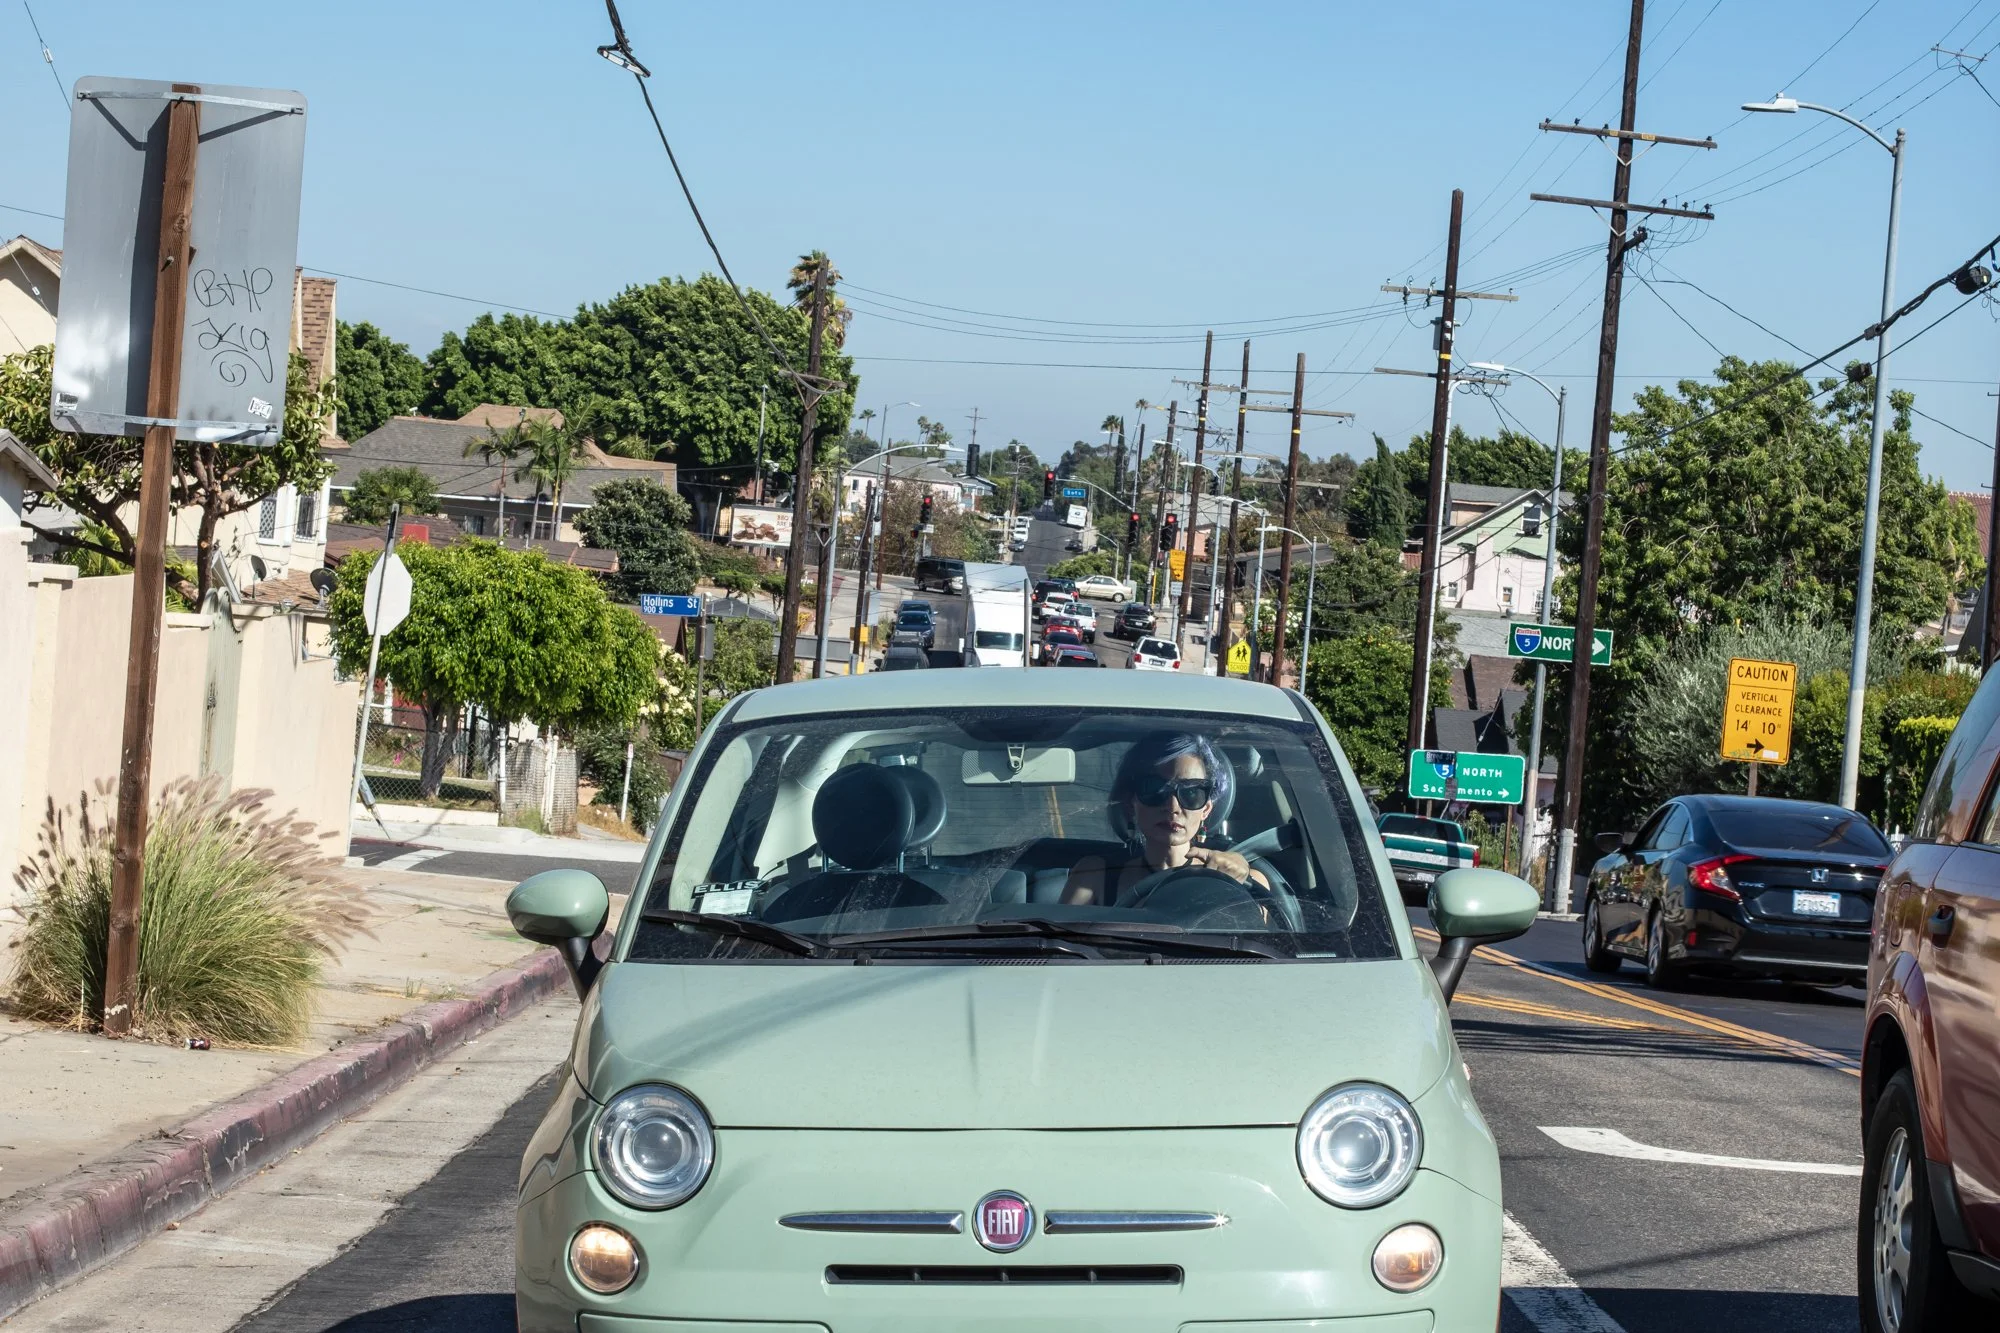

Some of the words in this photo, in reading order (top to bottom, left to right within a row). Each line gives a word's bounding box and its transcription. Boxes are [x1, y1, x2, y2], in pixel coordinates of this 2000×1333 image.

[643, 595, 674, 608] Hollins
[687, 597, 698, 609] St
[643, 605, 656, 613] 900
[1524, 638, 1531, 647] 5
[1542, 636, 1574, 651] NOR
[1230, 663, 1248, 671] SCHOO
[1737, 665, 1788, 682] CAUTION
[1741, 691, 1779, 703] VERTICAL
[1734, 704, 1782, 716] CLEARANCE
[1441, 764, 1449, 775] 5
[1462, 767, 1503, 777] NORTH
[1423, 783, 1493, 796] Sacmento
[694, 880, 760, 894] ELLIS
[987, 1208, 1022, 1235] FIAT
